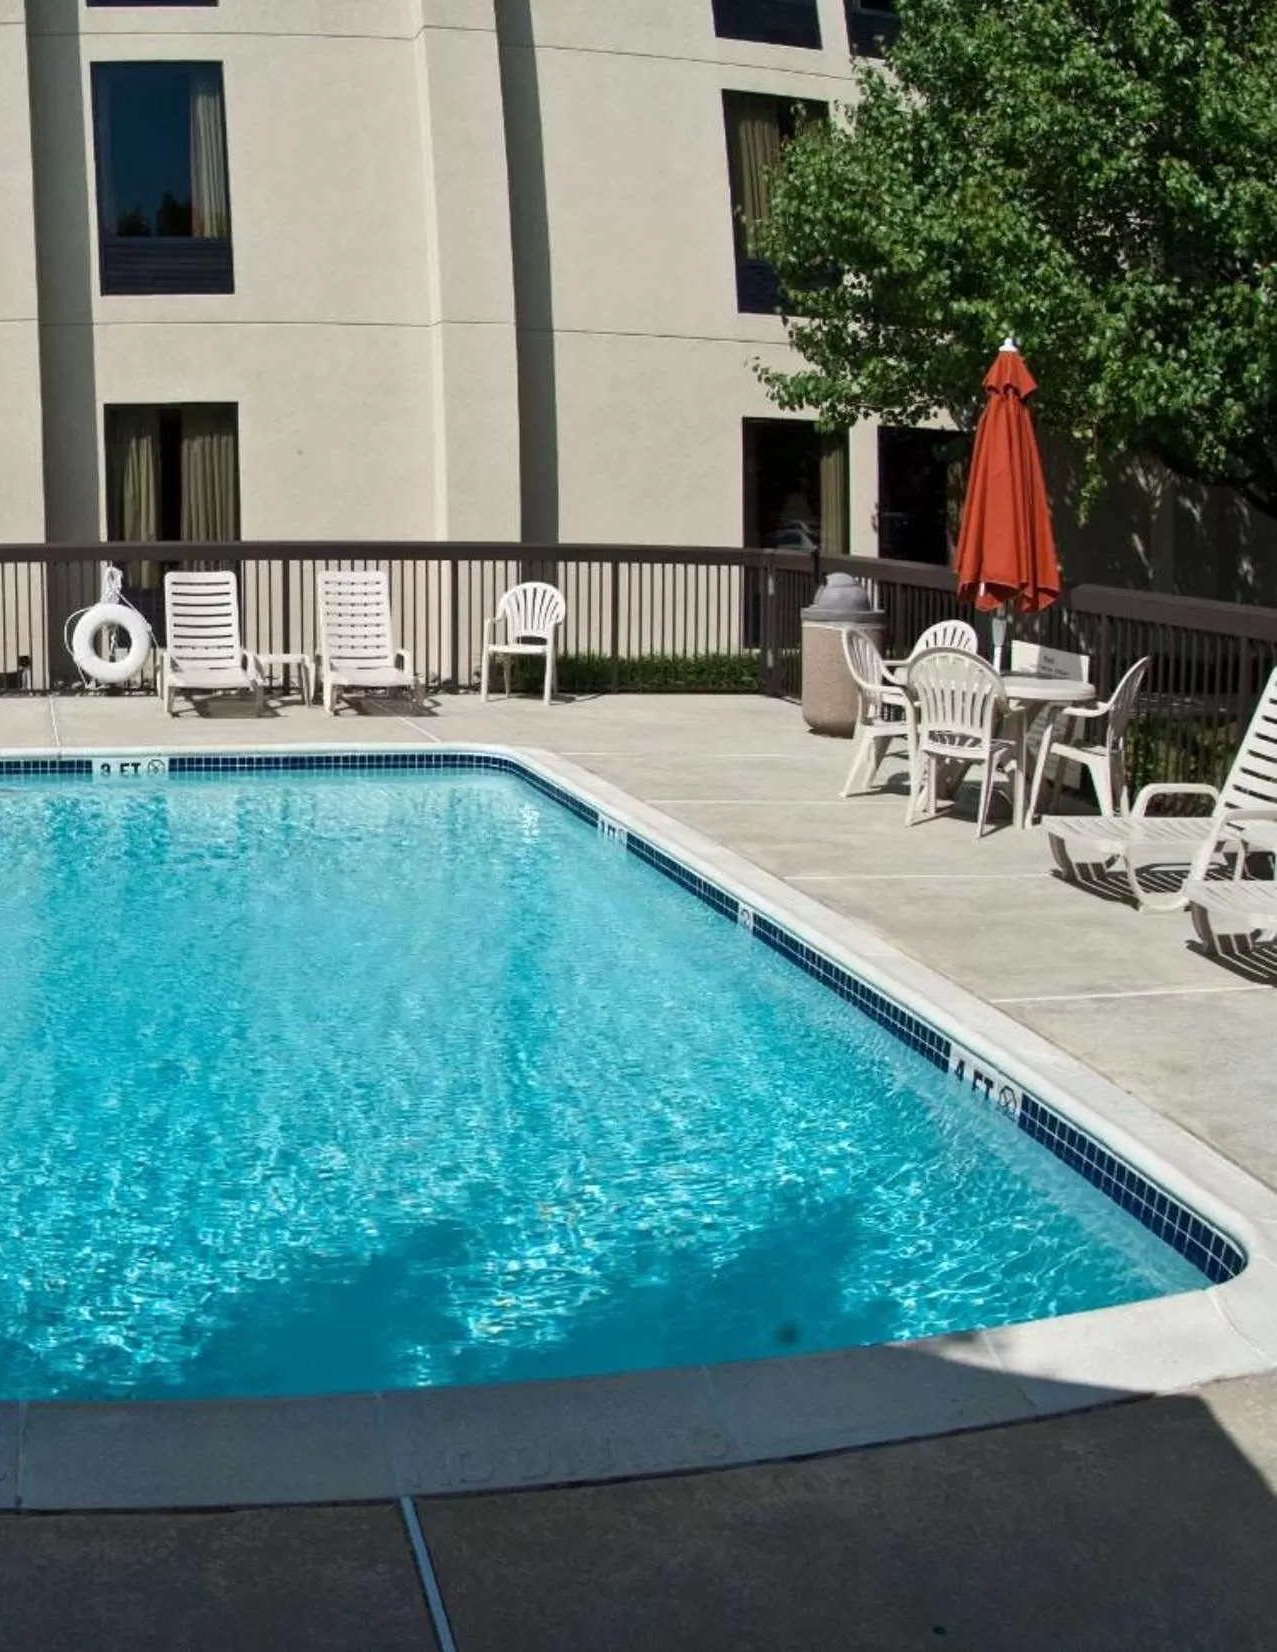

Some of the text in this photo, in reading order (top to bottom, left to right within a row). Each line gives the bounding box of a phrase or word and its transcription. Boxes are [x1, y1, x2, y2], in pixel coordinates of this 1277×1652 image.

[99, 762, 141, 778] 3 FT
[972, 1070, 994, 1101] FT
